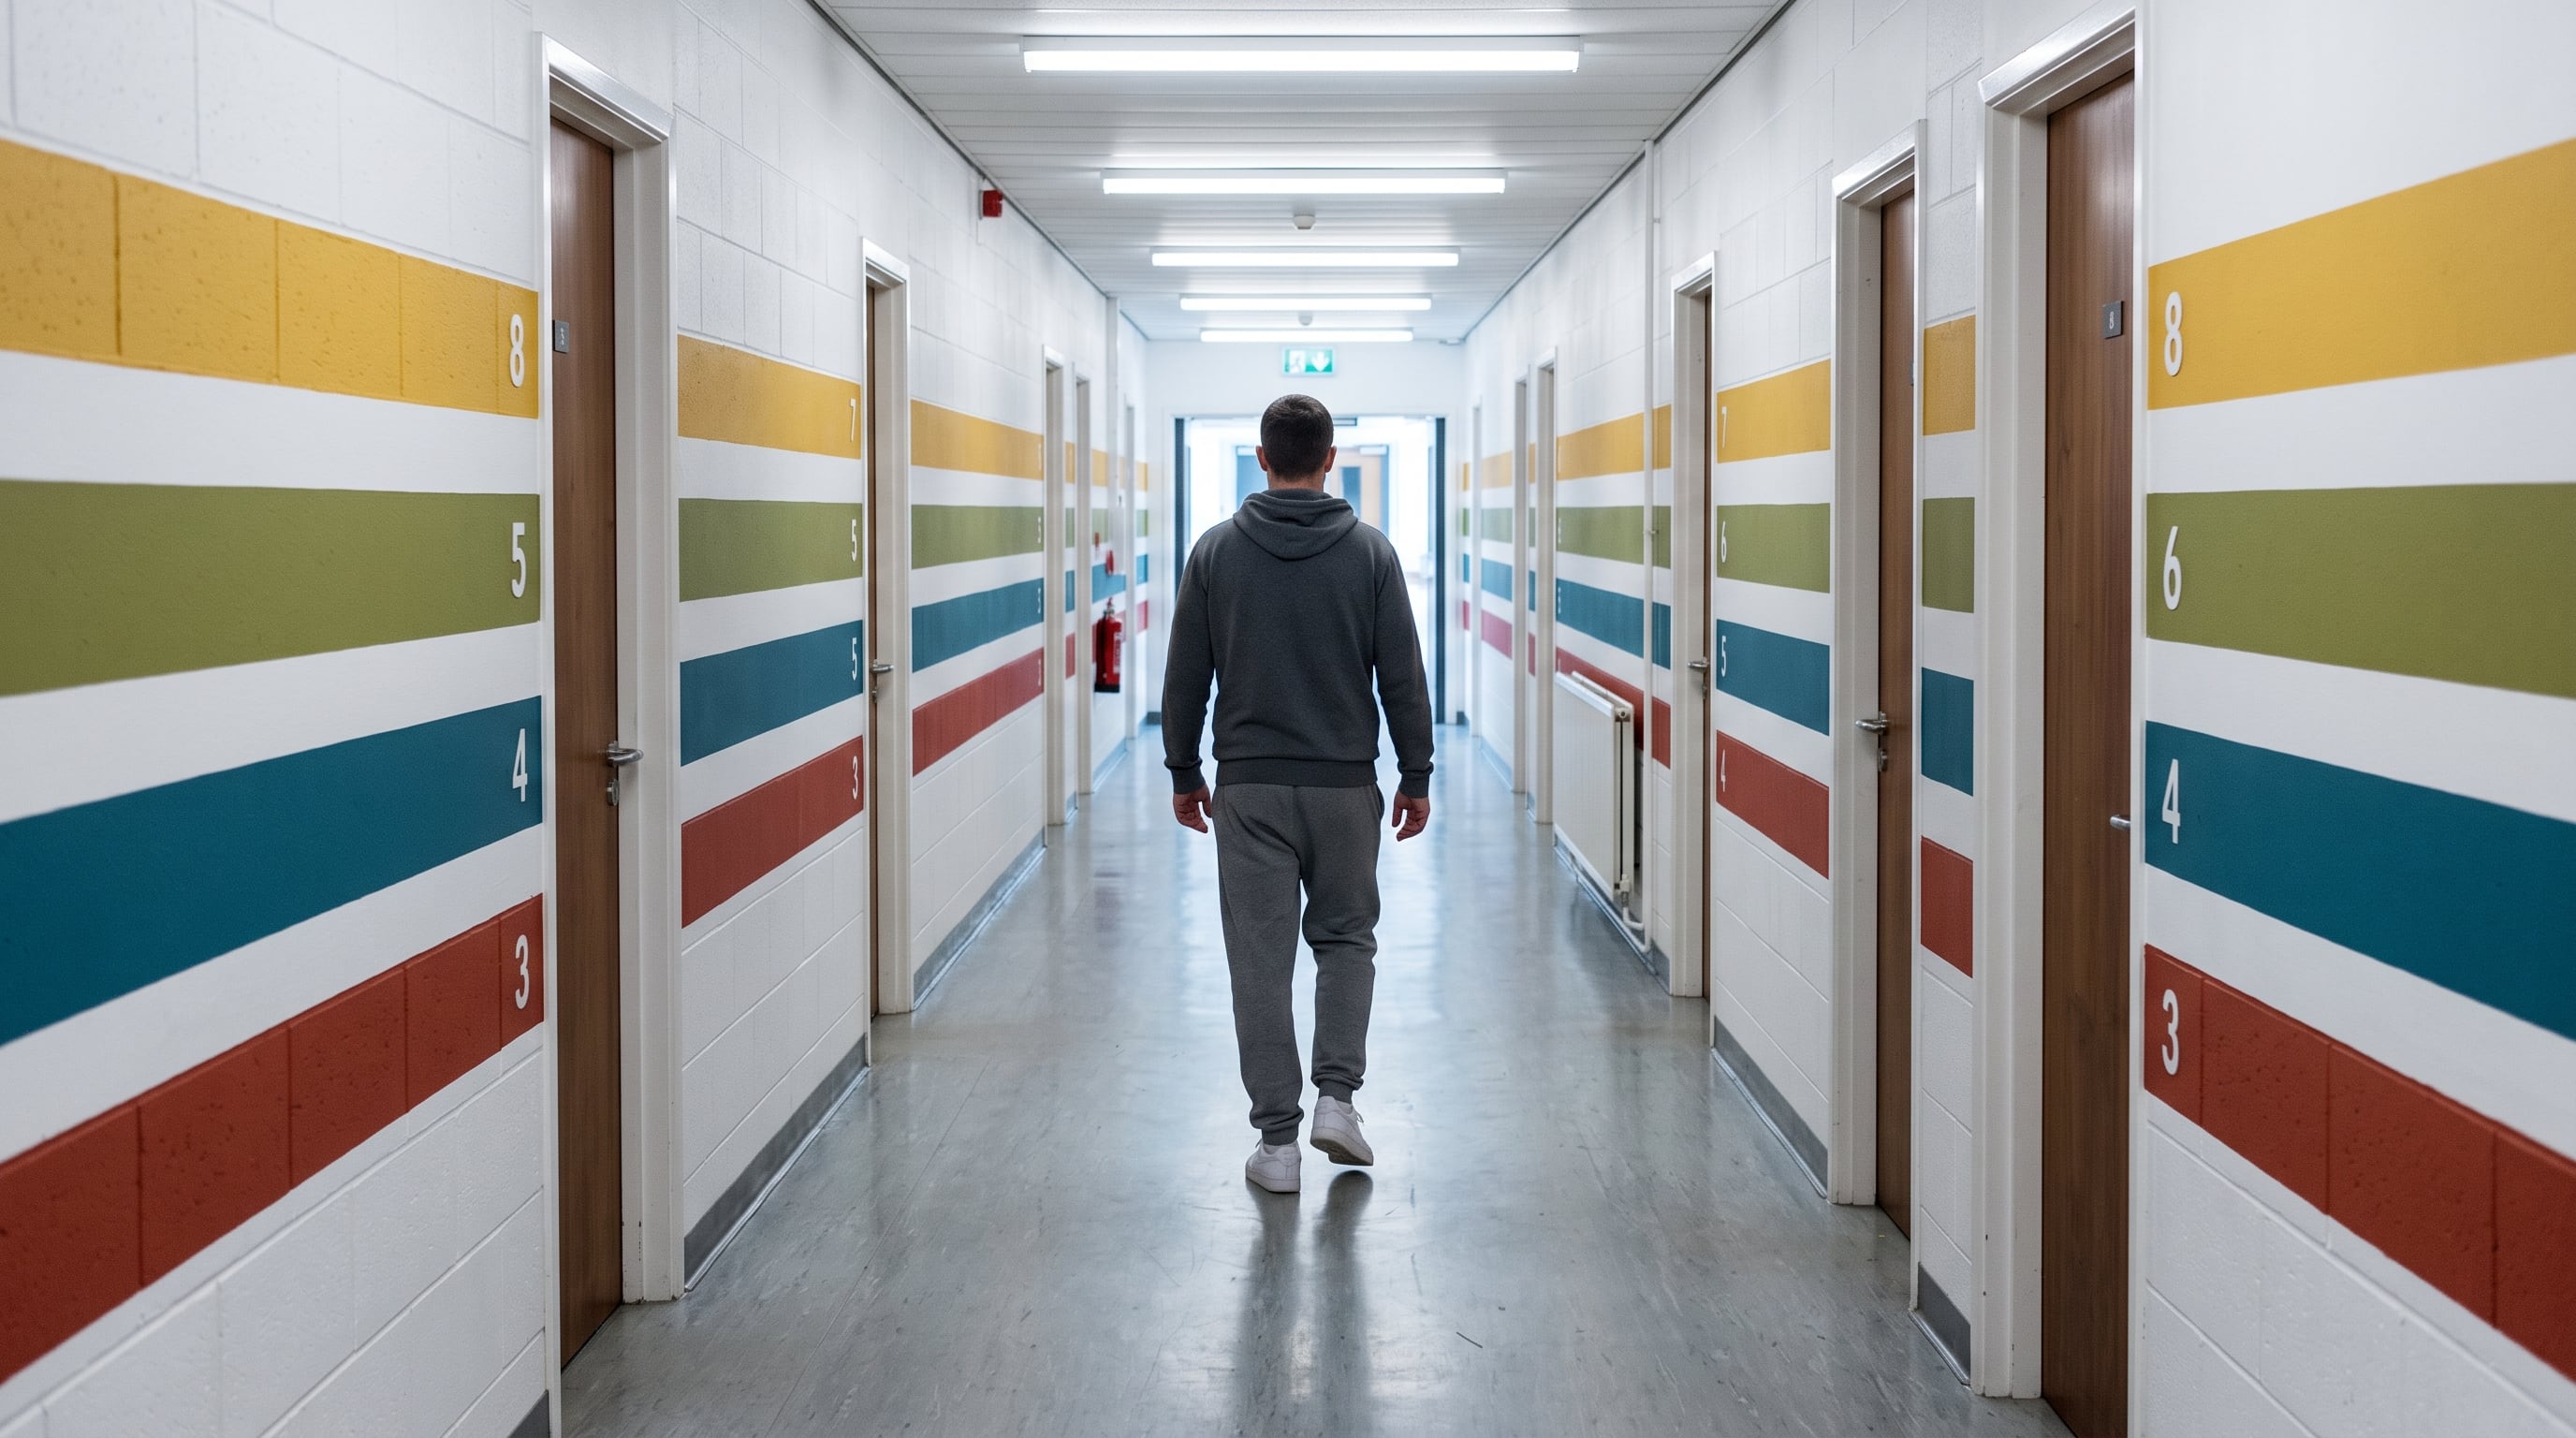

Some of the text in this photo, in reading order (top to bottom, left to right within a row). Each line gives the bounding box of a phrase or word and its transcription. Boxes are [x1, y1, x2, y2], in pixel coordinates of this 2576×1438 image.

[509, 314, 525, 388] 8
[2163, 291, 2183, 376] 8
[850, 398, 856, 442] 7
[1721, 405, 1728, 448] 7
[511, 521, 526, 598] 5
[851, 519, 857, 562] 5
[1720, 521, 1727, 563] 6
[2163, 525, 2182, 610] 6
[852, 637, 857, 681] 5
[1720, 635, 1727, 677] 5
[512, 727, 528, 802] 4
[852, 756, 858, 800] 3
[1720, 749, 1726, 792] 4
[2161, 758, 2181, 844] 4
[515, 934, 530, 1009] 3
[2161, 989, 2179, 1075] 3
